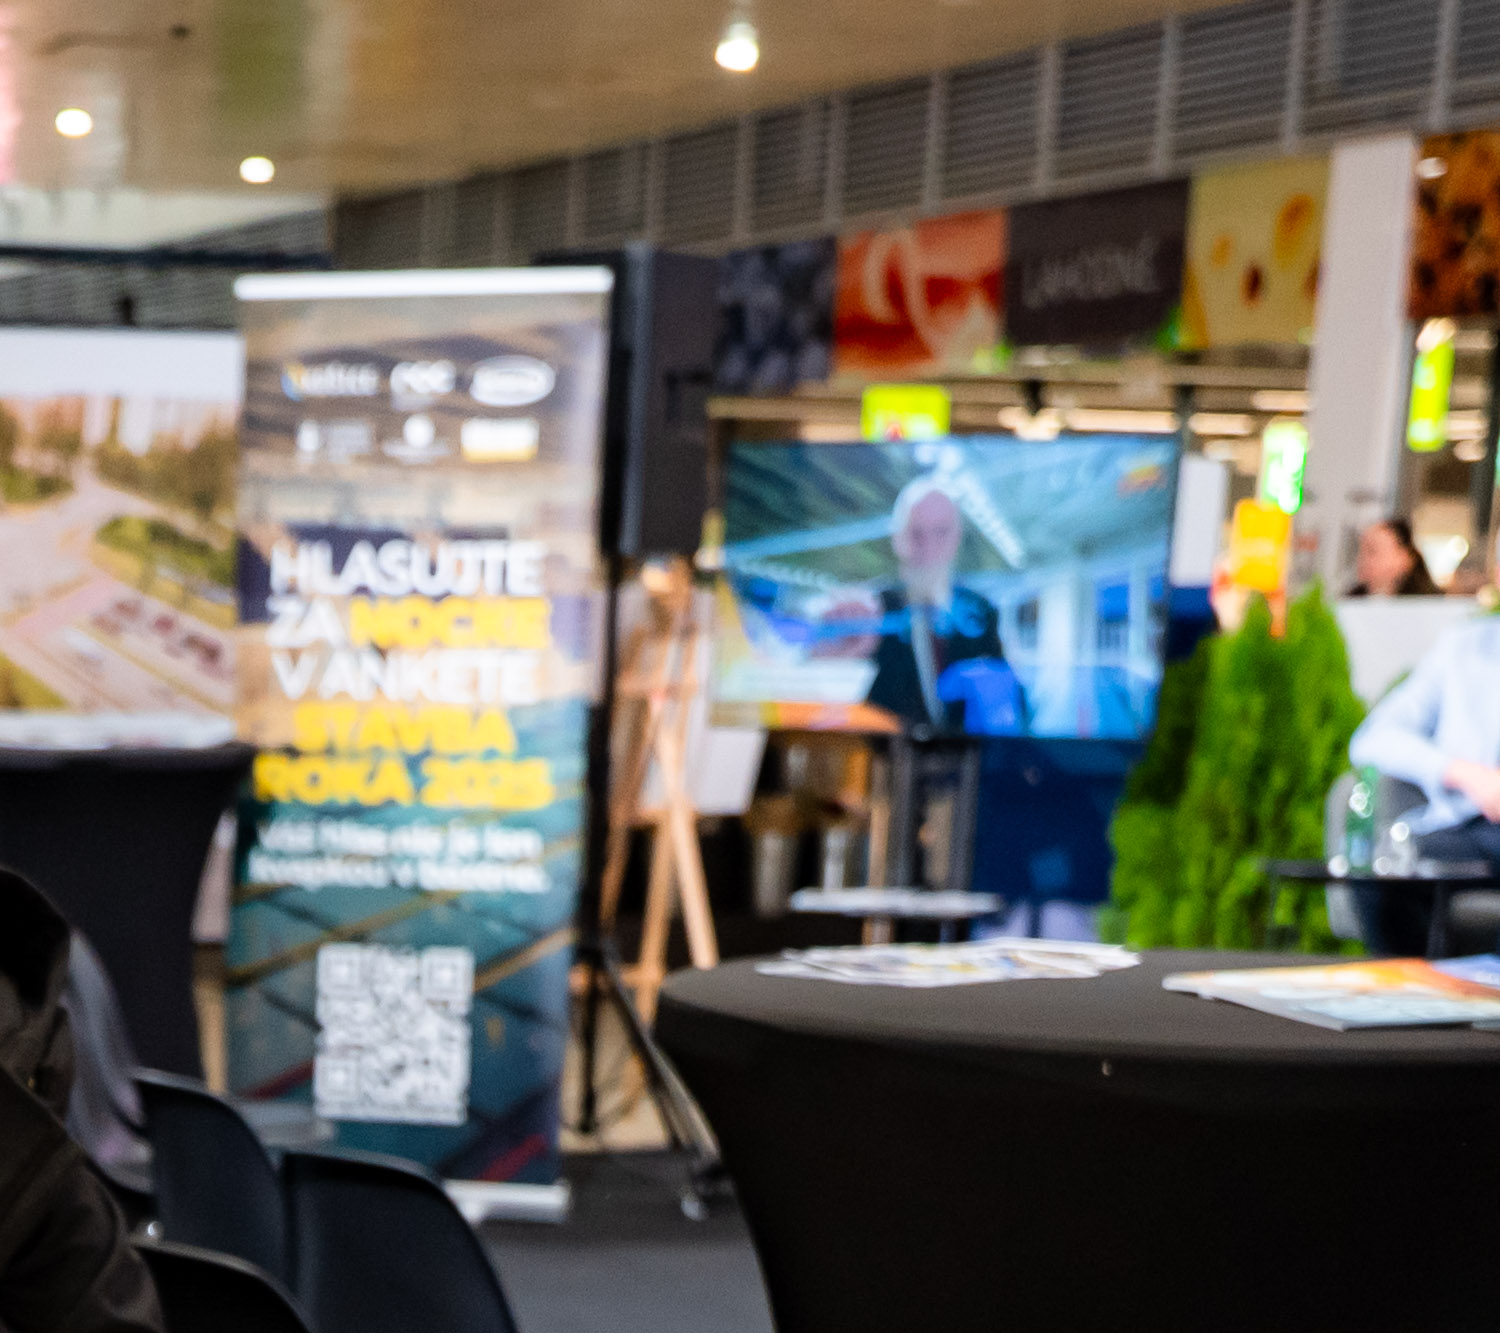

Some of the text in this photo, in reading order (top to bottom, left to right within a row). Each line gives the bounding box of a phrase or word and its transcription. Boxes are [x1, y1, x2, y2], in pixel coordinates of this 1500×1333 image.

[270, 540, 545, 597] HLASUJTE
[265, 597, 346, 648] ZA
[271, 648, 540, 703] V ANKETE
